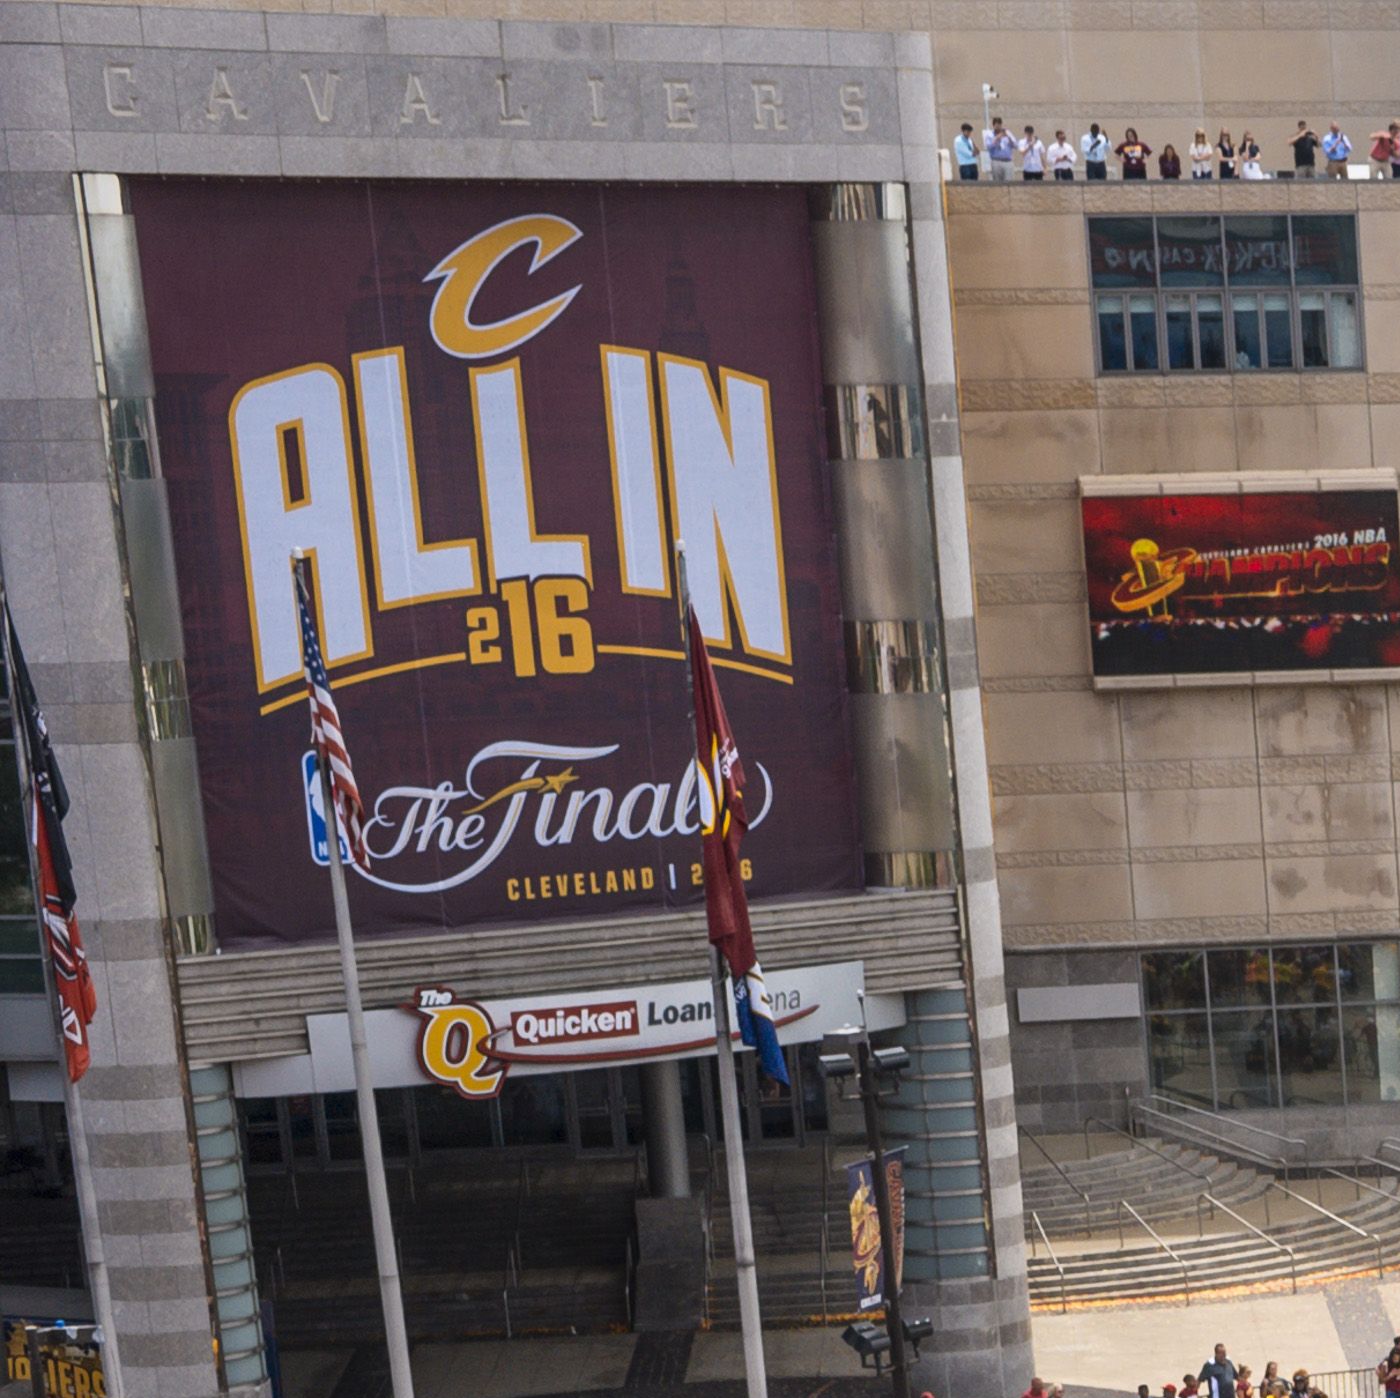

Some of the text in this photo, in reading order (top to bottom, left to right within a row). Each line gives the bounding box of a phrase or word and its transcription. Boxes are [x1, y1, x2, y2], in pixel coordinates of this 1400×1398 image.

[104, 62, 870, 132] CAVALIERS
[228, 343, 793, 695] ALL IN
[1314, 533, 1348, 548] 2016
[1353, 527, 1387, 543] NBA
[466, 576, 594, 677] 216
[362, 740, 772, 893] The Final
[318, 841, 344, 858] NA
[507, 859, 752, 900] CLEVELAND 26
[420, 989, 453, 1006] The
[517, 1007, 634, 1043] Quicken
[647, 1001, 716, 1027] Loan
[419, 1004, 505, 1095] Q
